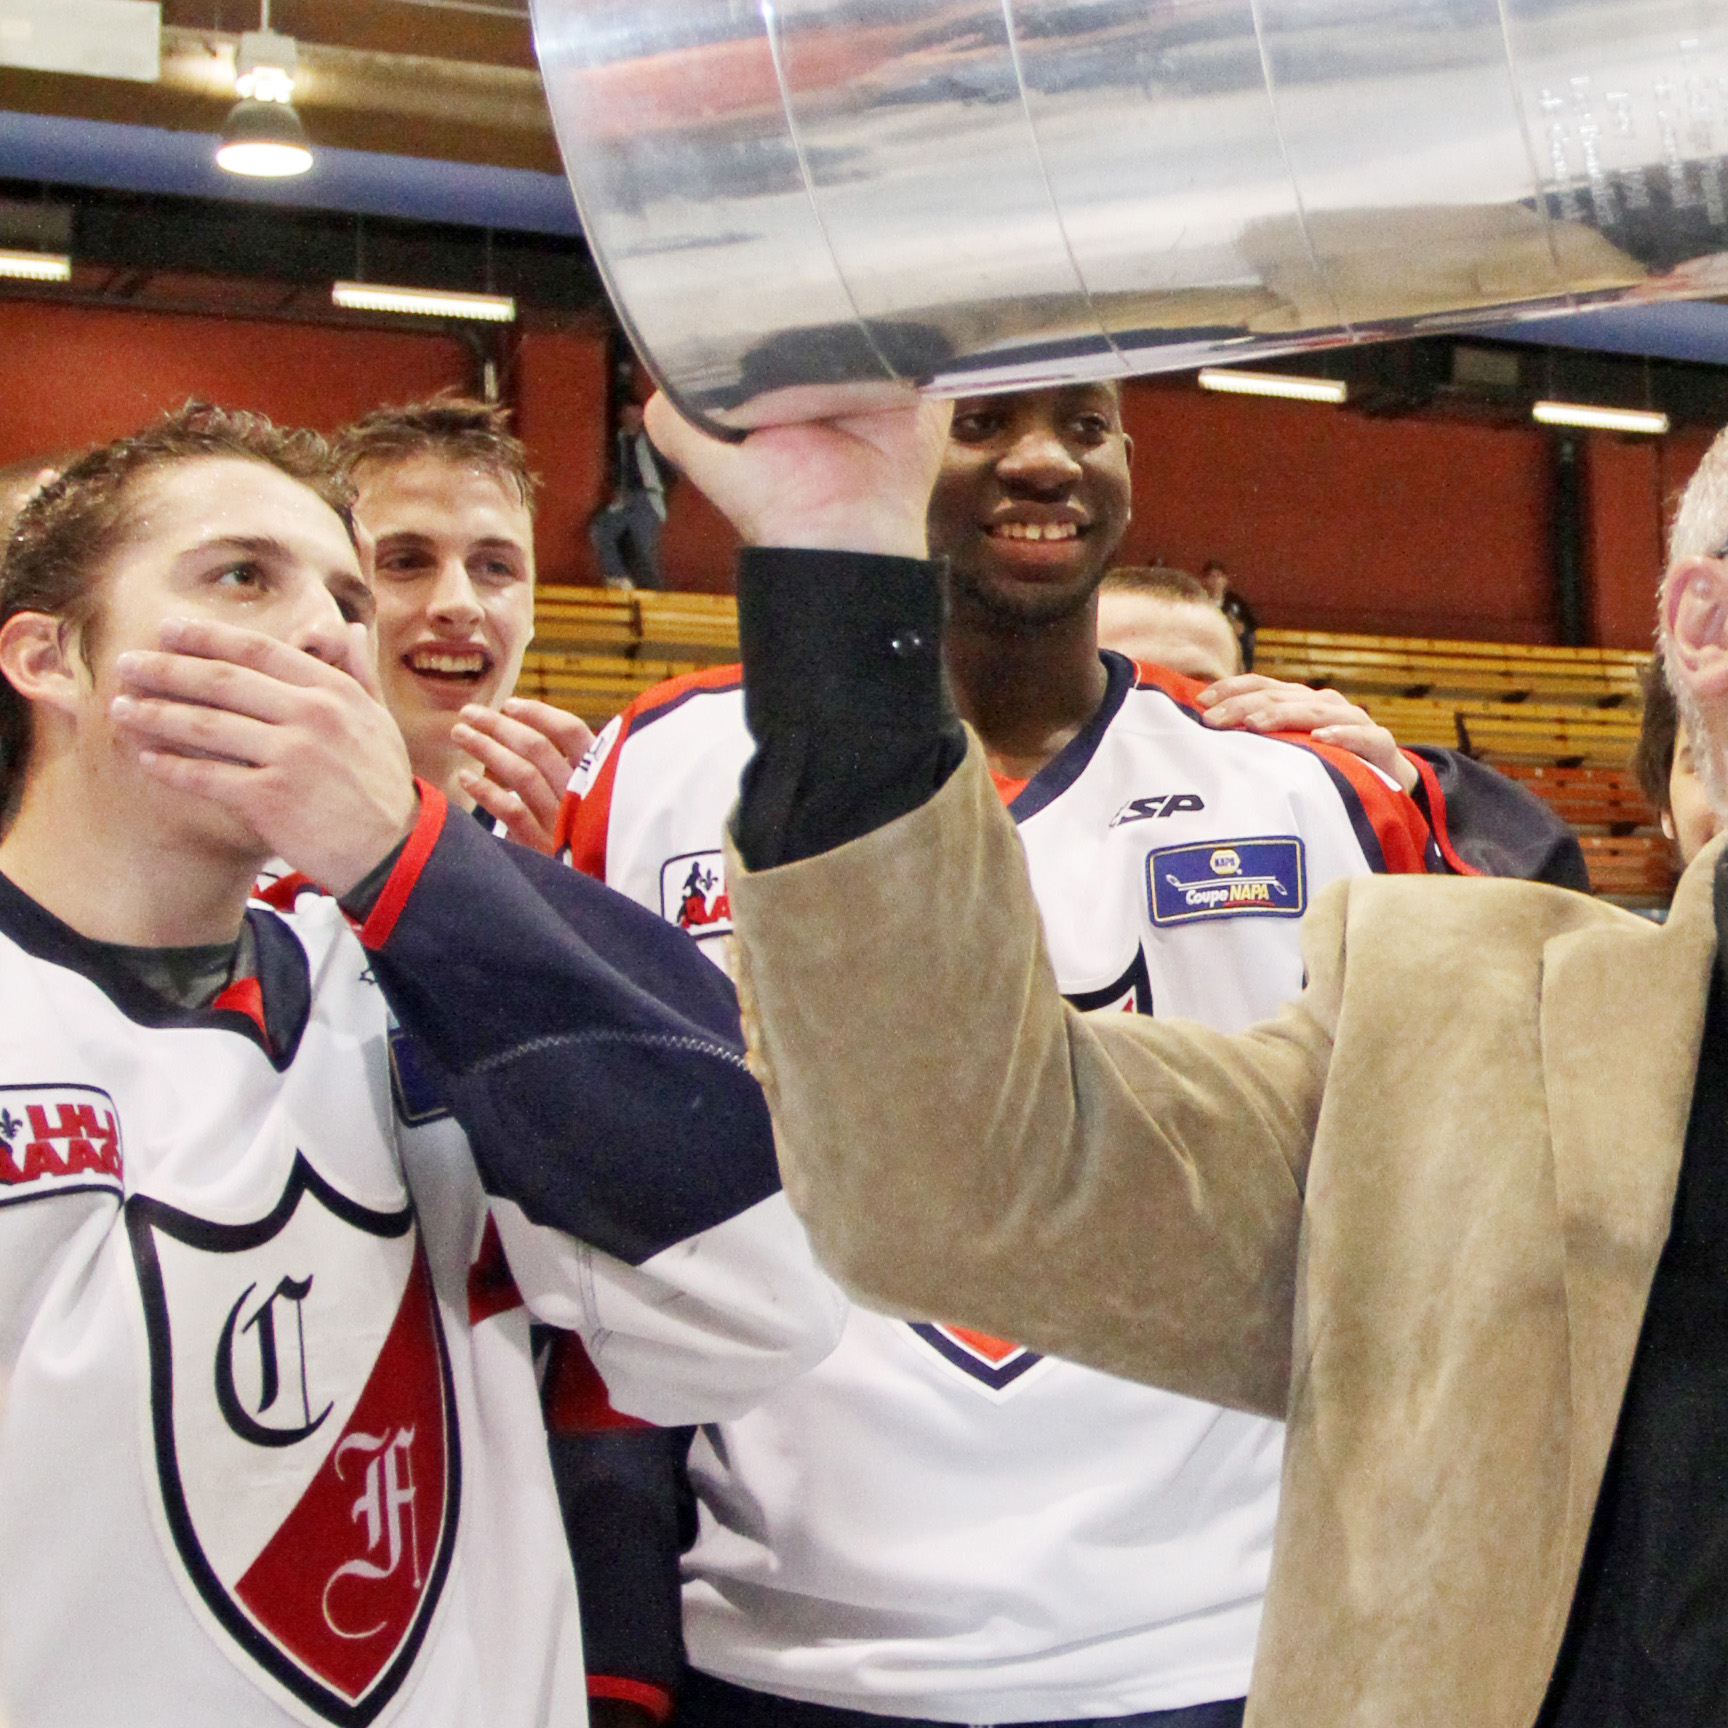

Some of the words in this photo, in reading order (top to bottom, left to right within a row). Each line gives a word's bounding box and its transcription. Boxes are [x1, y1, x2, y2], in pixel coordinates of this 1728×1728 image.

[1214, 857, 1236, 868] NAPA
[1185, 888, 1230, 908] Coupe
[1229, 884, 1271, 902] NAPA
[213, 1273, 337, 1448] C
